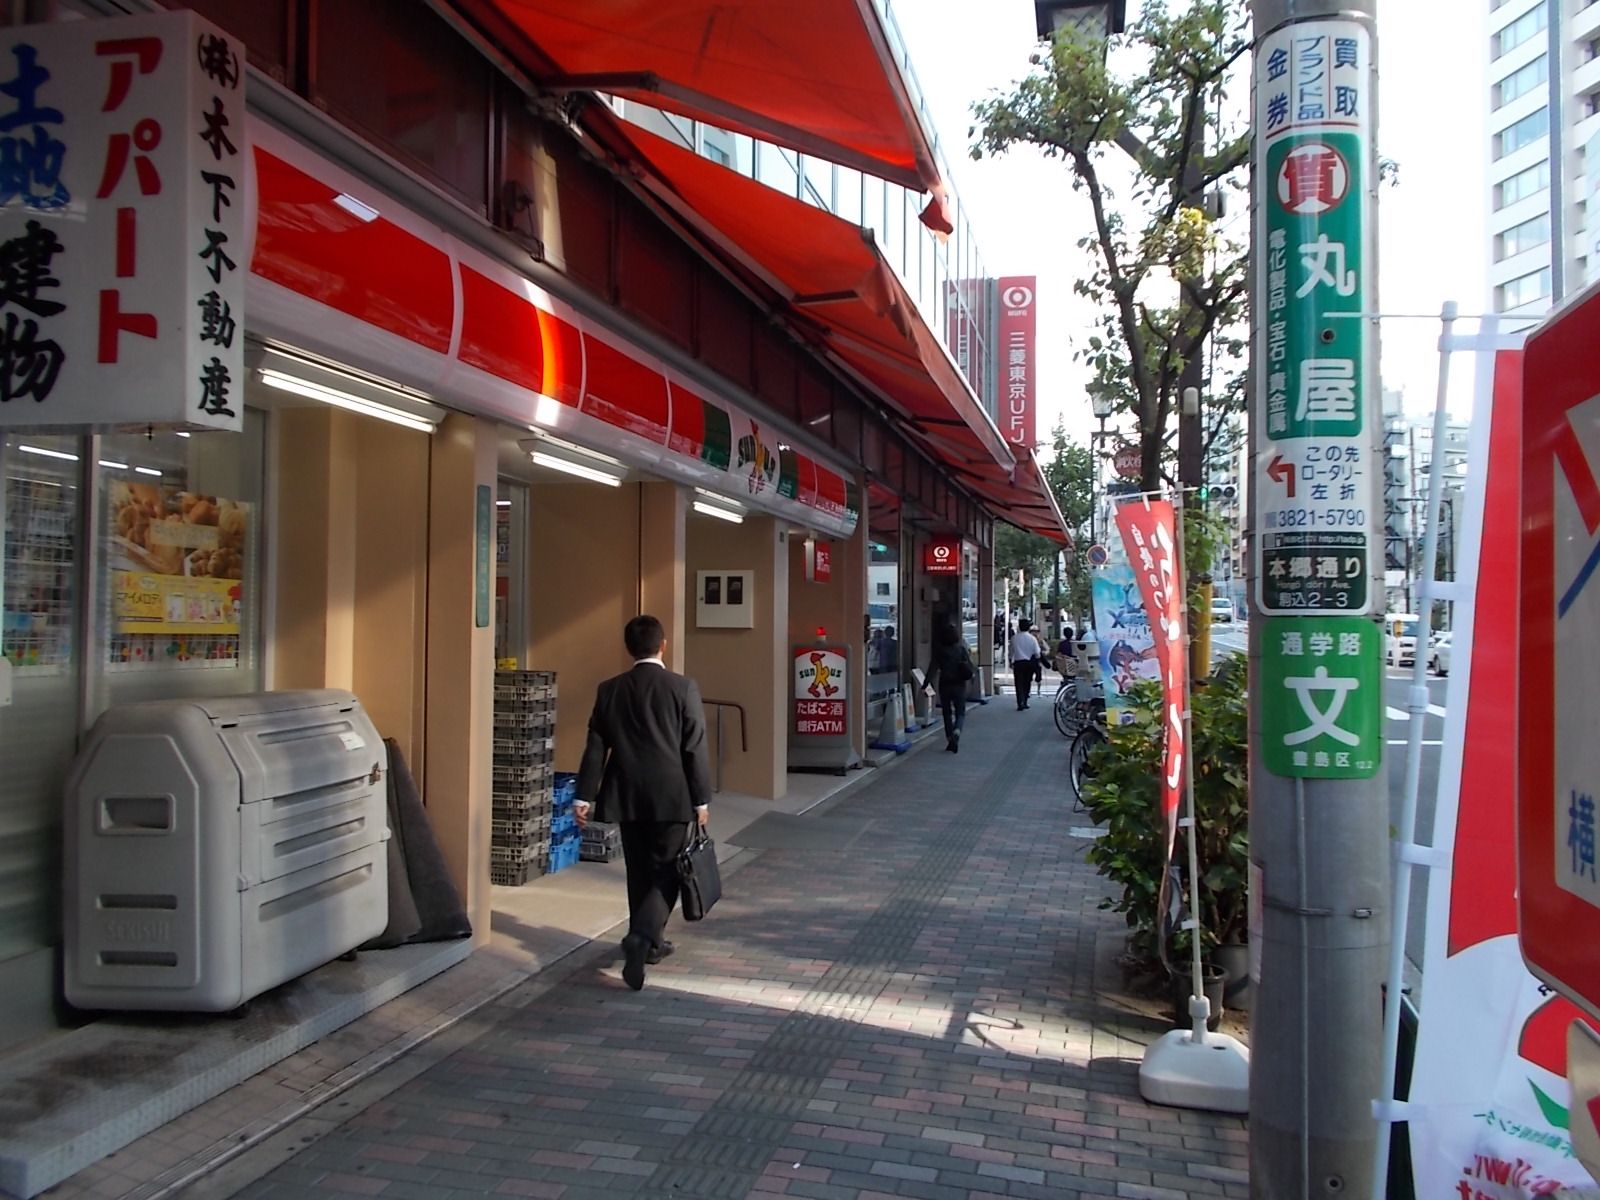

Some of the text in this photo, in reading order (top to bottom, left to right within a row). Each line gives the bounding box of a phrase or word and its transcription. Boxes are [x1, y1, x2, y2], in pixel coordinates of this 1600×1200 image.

[1267, 48, 1288, 130] 金券
[1297, 36, 1325, 120] ブランド品
[1334, 38, 1359, 117] 買取
[0, 43, 71, 402] 土地建物
[95, 37, 163, 364] アパート
[198, 32, 238, 419] (株)木下不動産
[1295, 233, 1356, 421] 丸屋
[1009, 331, 1026, 447] 三菱東京UFJ
[1301, 465, 1363, 481] ロータリー
[1305, 446, 1360, 462] この先
[1311, 483, 1357, 500] 左折
[1278, 509, 1365, 527] 3821-5790
[1268, 556, 1362, 579] 本郷通り
[1281, 631, 1361, 656] 通学路
[797, 702, 843, 716] たばこ・酒
[797, 720, 843, 733] 銀行ATM
[1283, 666, 1361, 746] 文
